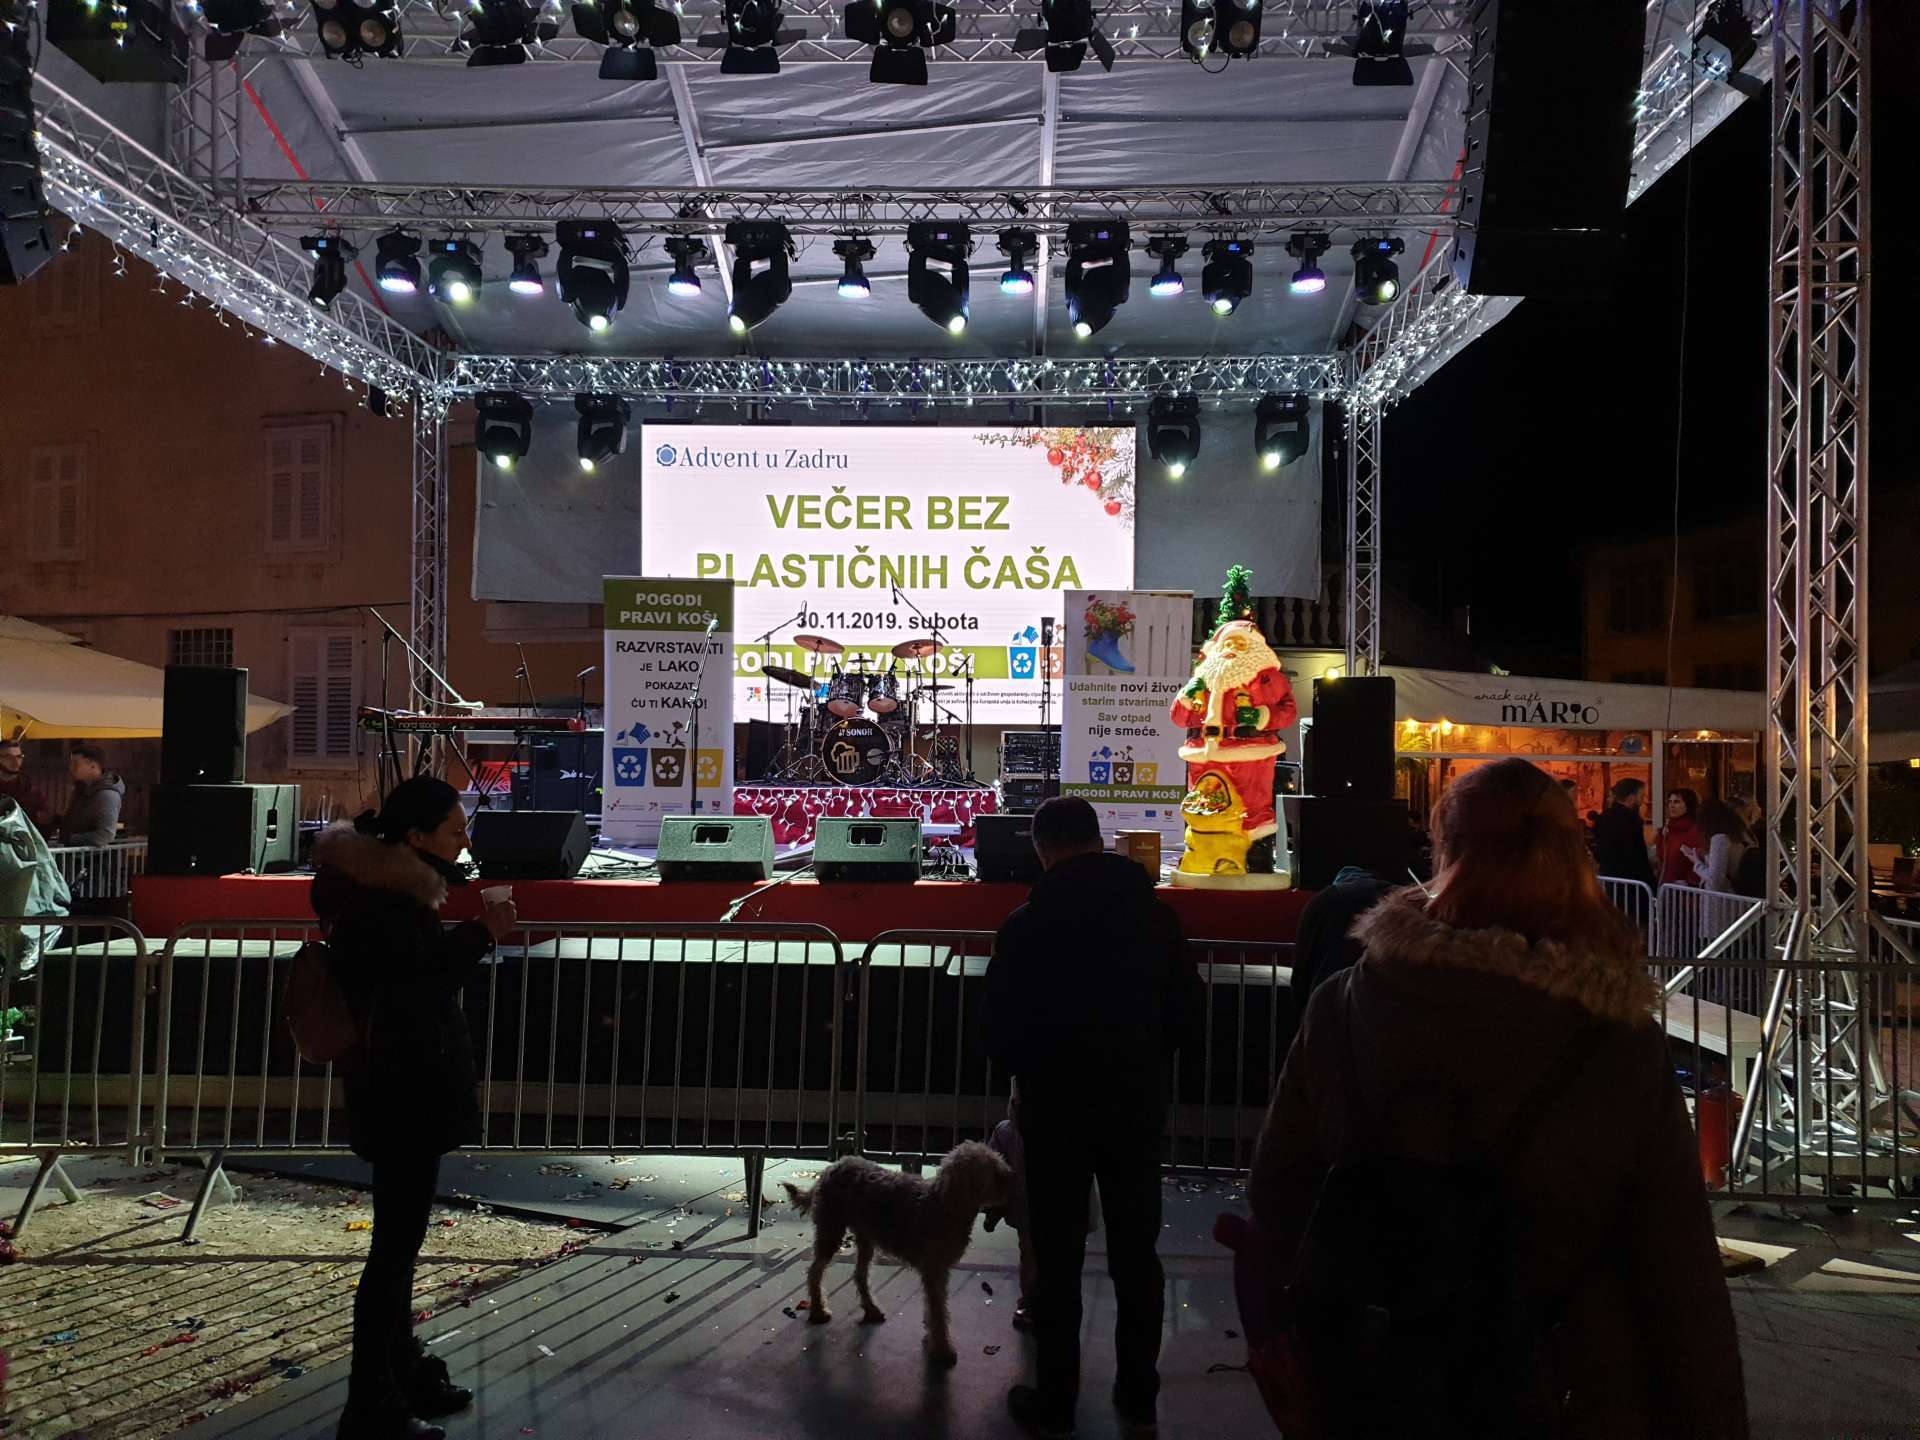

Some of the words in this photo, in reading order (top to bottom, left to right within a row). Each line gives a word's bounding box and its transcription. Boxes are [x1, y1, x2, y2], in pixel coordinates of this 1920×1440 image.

[680, 446, 760, 468] Advent
[766, 455, 779, 469] u
[785, 448, 849, 469] Zadru
[766, 485, 913, 530] VEČER
[927, 495, 1010, 530] BEZ
[696, 545, 948, 589] PLASTIČNIH
[963, 545, 1083, 590] ČAŠA
[635, 592, 702, 607] POGODI
[620, 610, 672, 624] PRAVI
[797, 612, 902, 630] 30.11.2019.
[908, 612, 979, 630] subota
[615, 640, 724, 655] RAZVRSTAVATI
[639, 663, 653, 672] JE
[658, 660, 700, 672] LAKO
[645, 681, 695, 691] POKAZAT
[1069, 682, 1117, 692] Udahnite
[1120, 681, 1148, 693] novi
[648, 699, 658, 709] TI
[1081, 696, 1116, 706] starim
[1097, 712, 1118, 722] Sav
[1120, 713, 1151, 725] otpad
[846, 728, 873, 737] SONOR
[1088, 724, 1112, 738] nije
[1114, 725, 1160, 737] smeće.
[1065, 788, 1110, 798] POGODI
[1113, 789, 1149, 799] PRAVI
